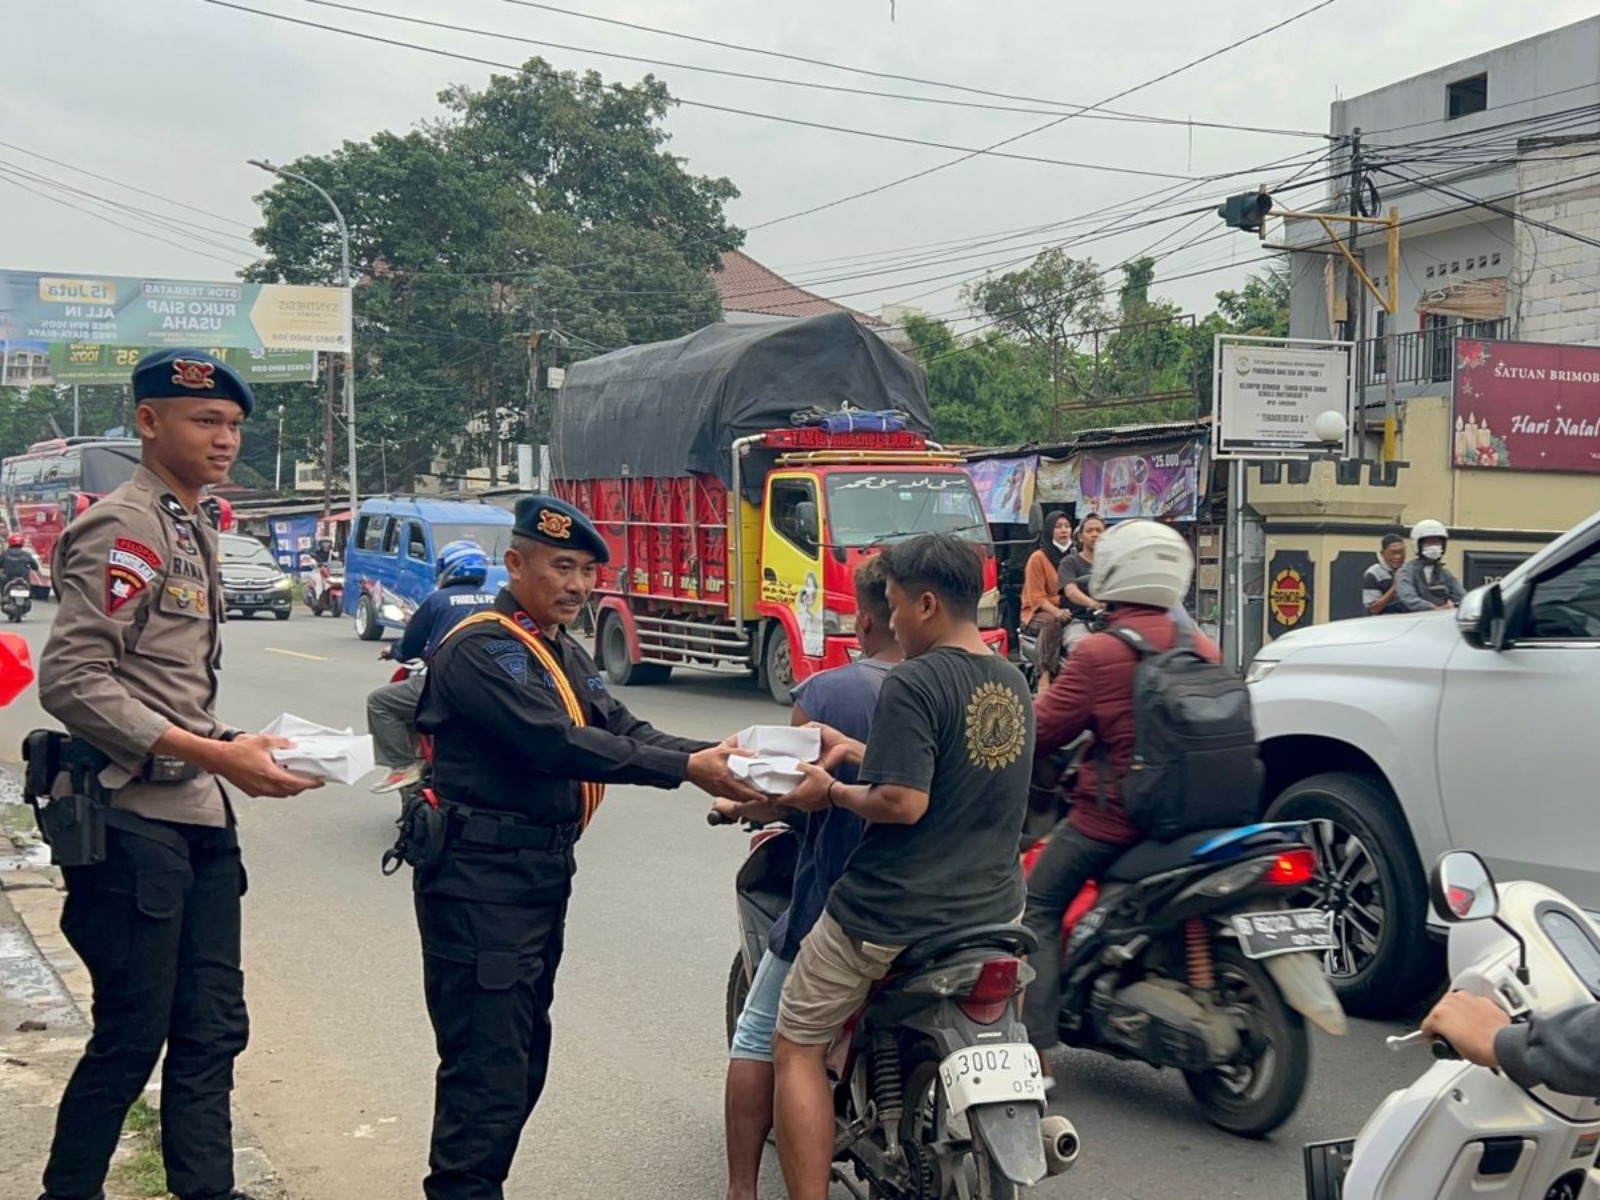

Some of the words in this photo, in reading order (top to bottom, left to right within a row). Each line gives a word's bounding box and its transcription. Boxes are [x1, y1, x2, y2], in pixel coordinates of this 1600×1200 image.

[1494, 367, 1545, 380] SATUAN
[1549, 370, 1600, 383] BRIMOB
[1511, 415, 1551, 435] Hari
[1554, 417, 1600, 437] Natal
[943, 1067, 953, 1088] B
[958, 1049, 1011, 1076] 3002
